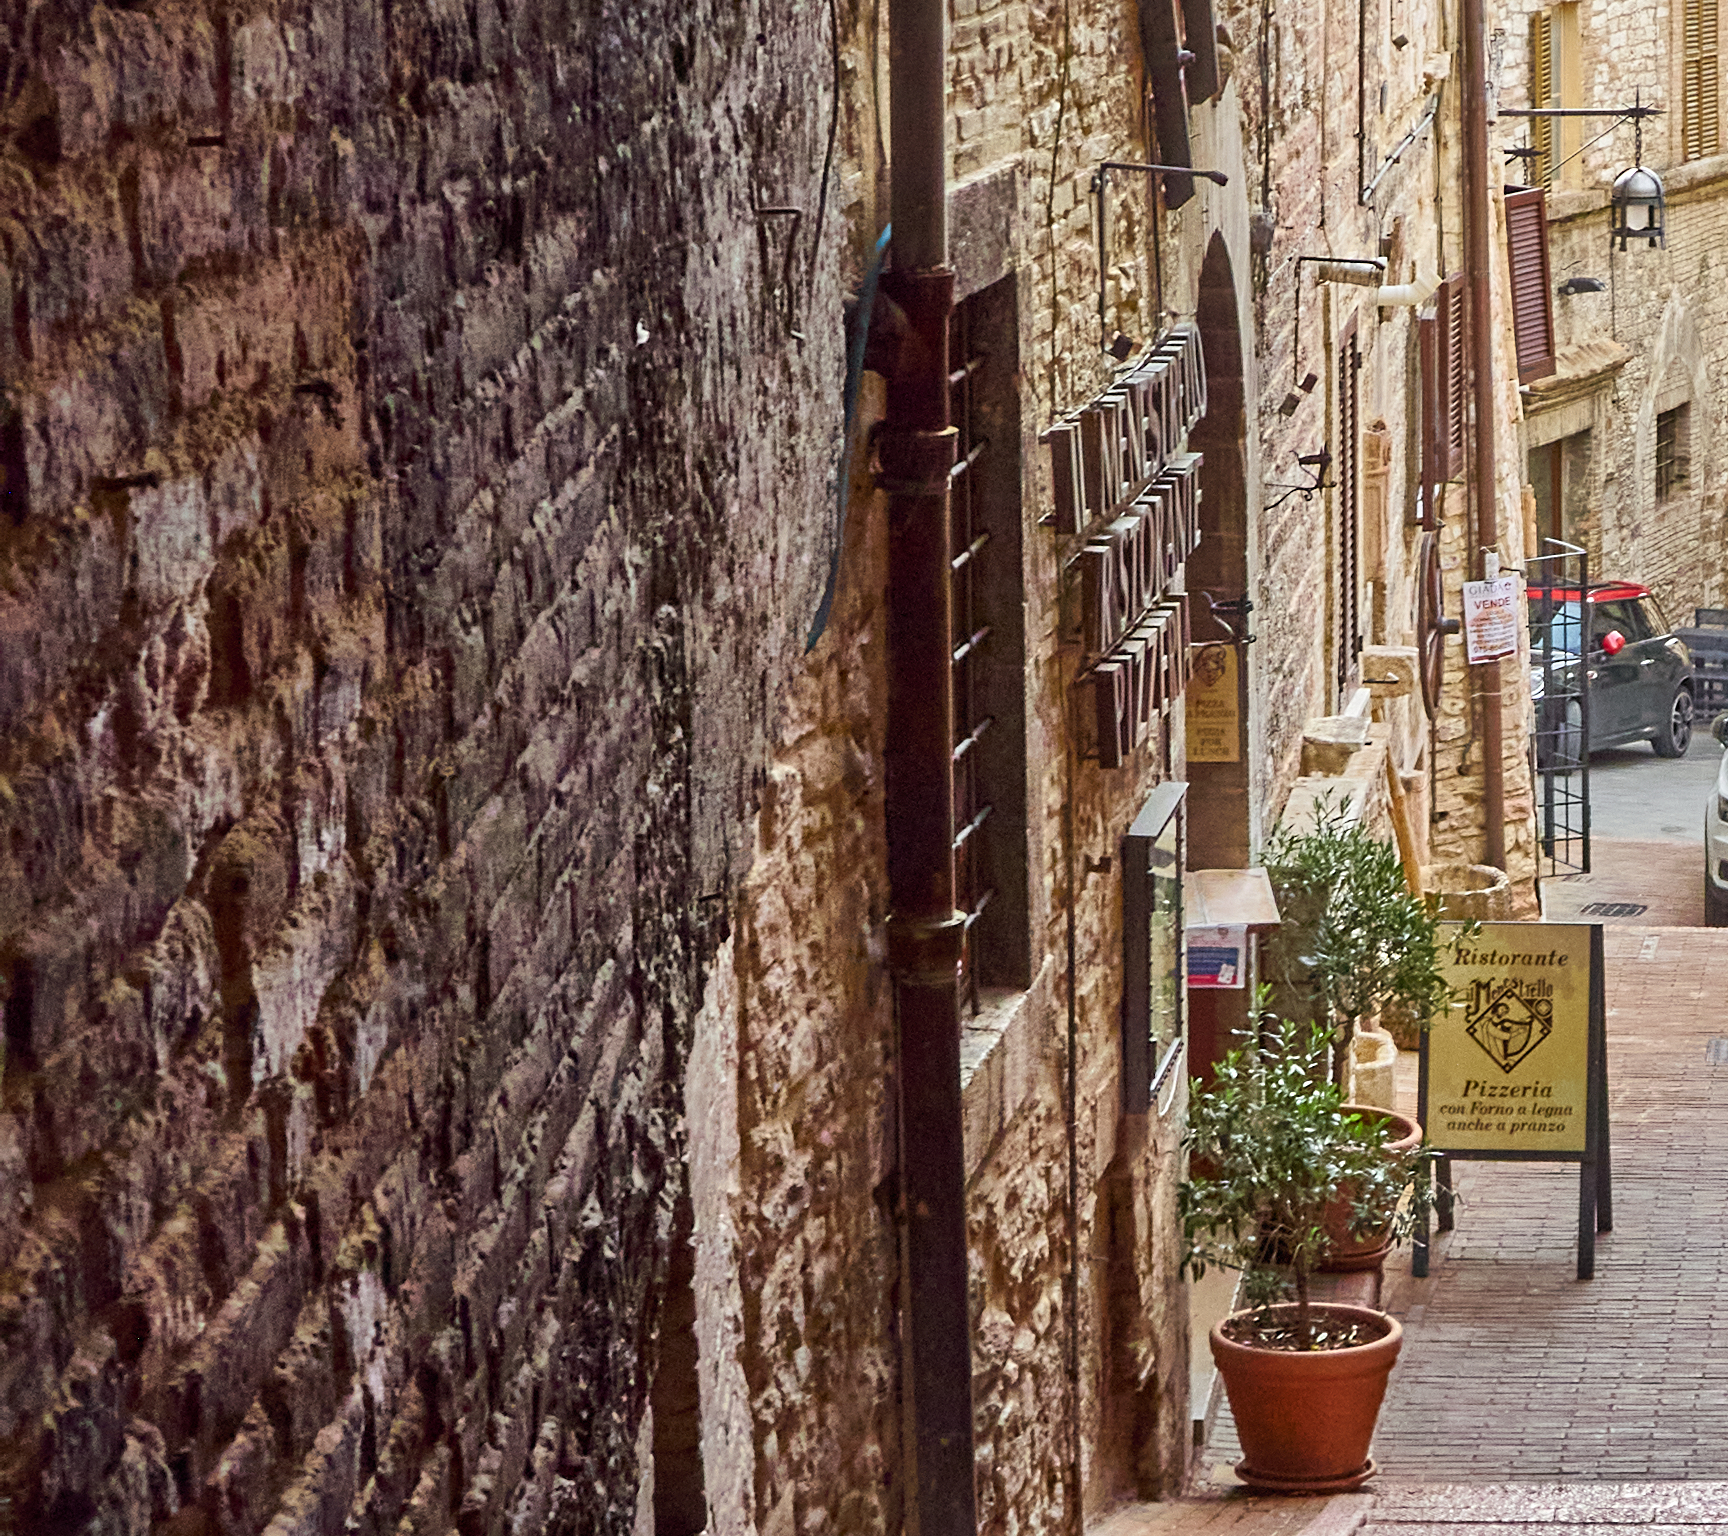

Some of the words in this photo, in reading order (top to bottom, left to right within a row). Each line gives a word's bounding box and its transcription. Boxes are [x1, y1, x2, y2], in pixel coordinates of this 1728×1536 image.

[1474, 597, 1511, 610] VENDE
[1109, 593, 1195, 768] PIZZERIA
[1452, 947, 1569, 968] Ristorante
[1461, 1079, 1553, 1099] Pizzeria
[1439, 1103, 1466, 1116] con
[1469, 1101, 1514, 1117] Forno
[1518, 1105, 1527, 1116] a
[1531, 1101, 1574, 1119] legna
[1446, 1115, 1494, 1132] anche
[1496, 1121, 1506, 1132] a
[1508, 1120, 1566, 1135] pranzo
